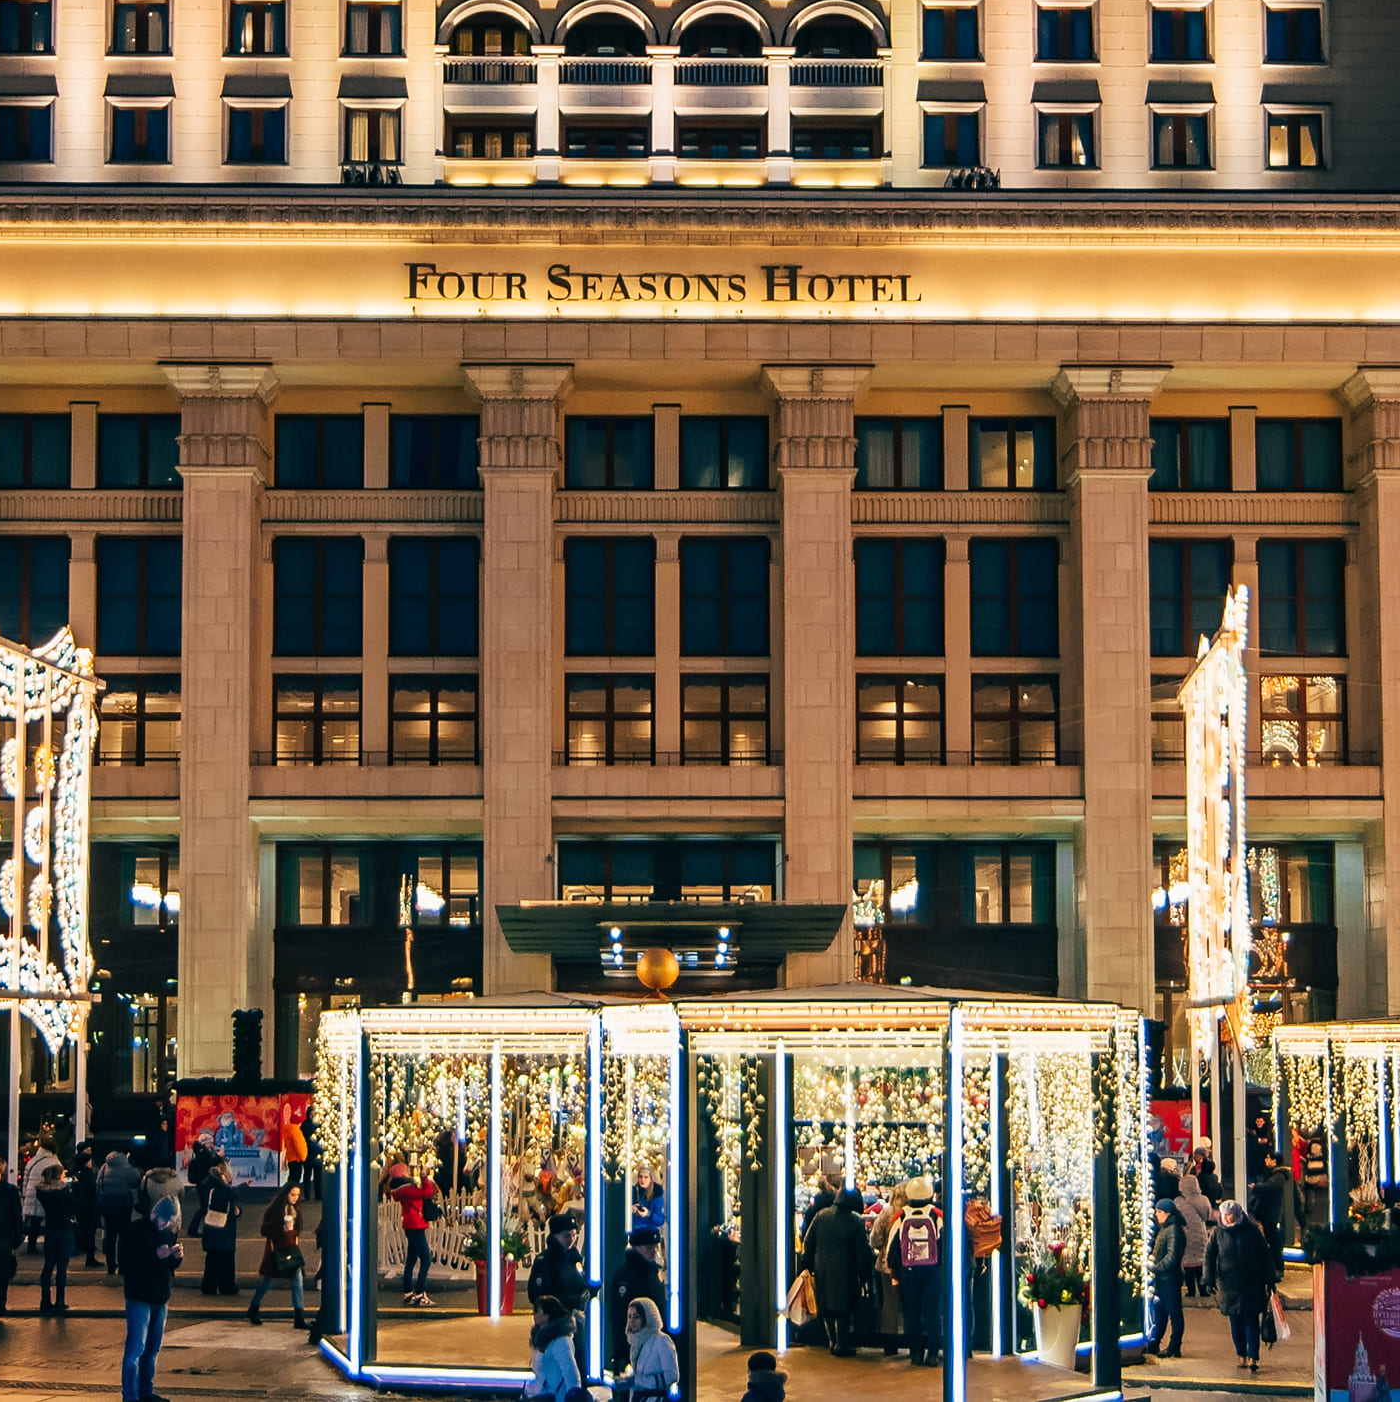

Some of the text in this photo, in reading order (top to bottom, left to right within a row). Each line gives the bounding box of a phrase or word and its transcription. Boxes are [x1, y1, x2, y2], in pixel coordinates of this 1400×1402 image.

[403, 262, 923, 303] FOUR SEASONS HOTEL
